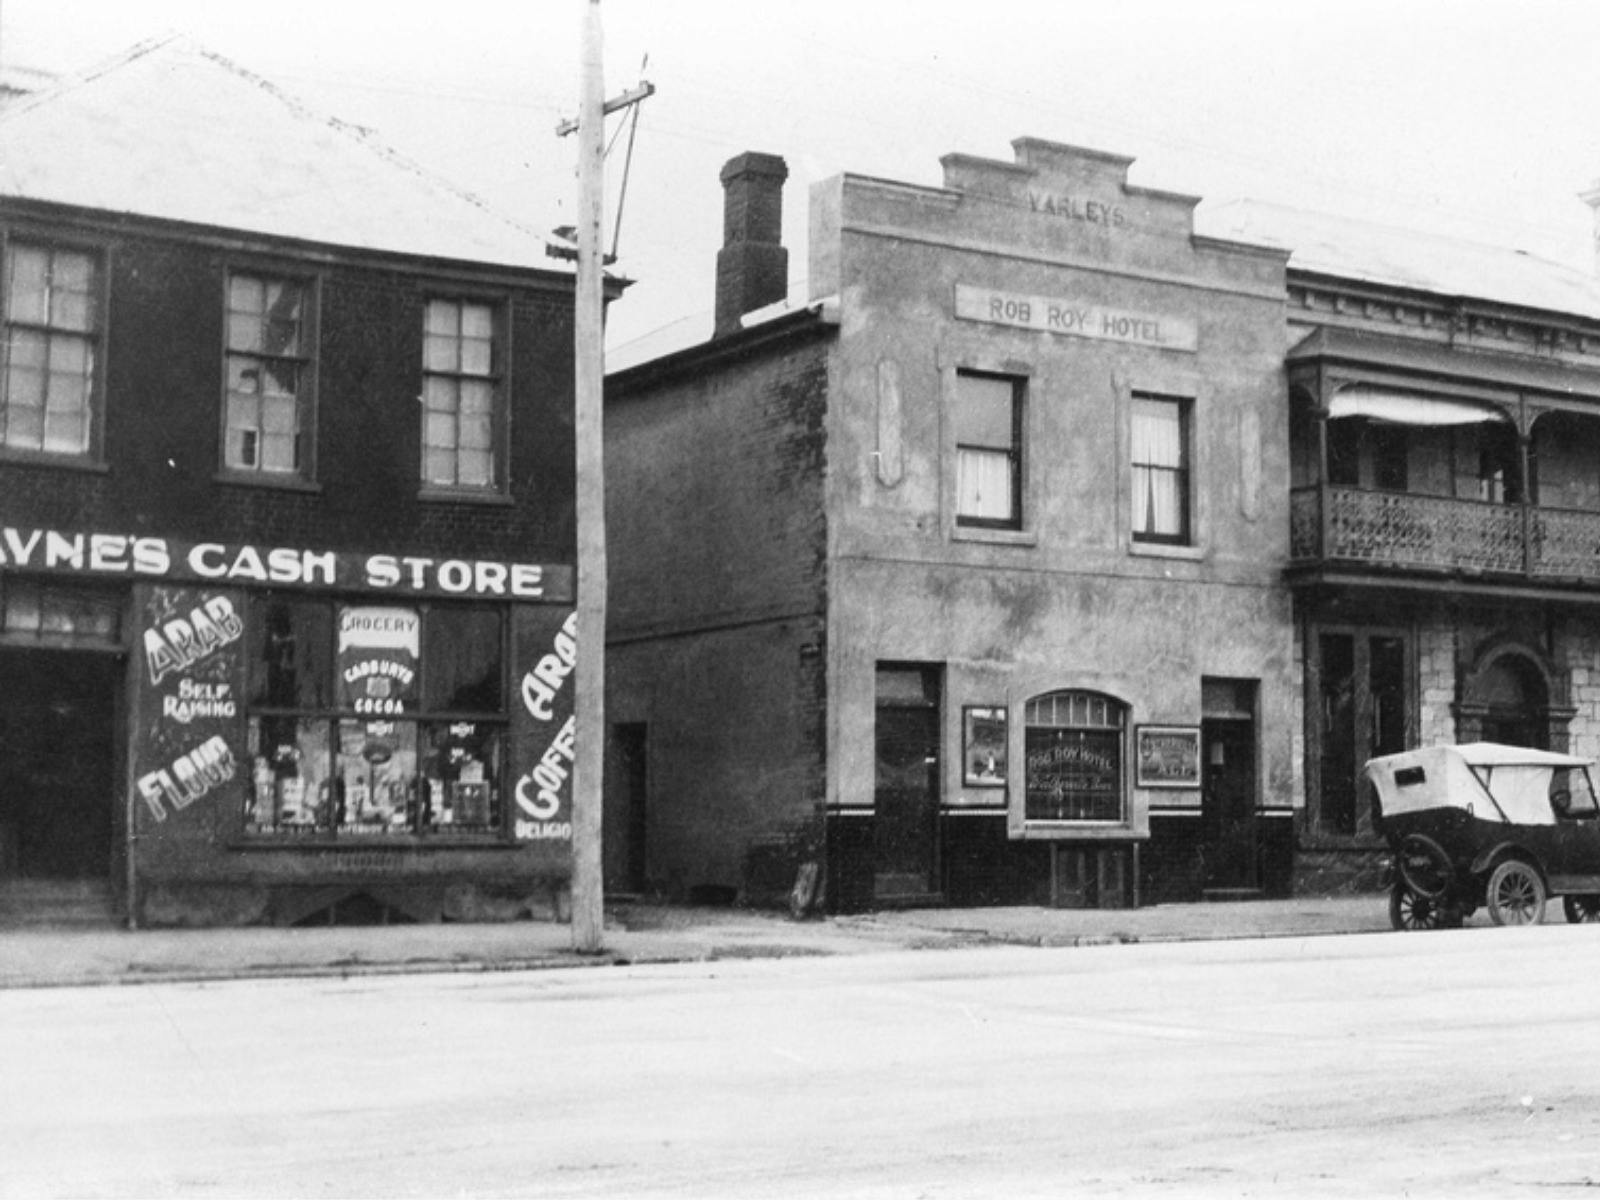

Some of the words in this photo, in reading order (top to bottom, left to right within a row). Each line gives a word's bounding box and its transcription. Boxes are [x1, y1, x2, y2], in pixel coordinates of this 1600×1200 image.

[989, 298, 1032, 323] ROB
[1047, 306, 1088, 331] ROY
[1102, 314, 1167, 343] HOTEL
[0, 527, 171, 575] YNE'S
[188, 542, 336, 584] CASH
[365, 554, 544, 596] STORE
[144, 595, 244, 686] ARAB
[342, 611, 416, 632] GROCERY
[163, 695, 237, 724] RAISING
[353, 698, 404, 715] COCOA
[137, 735, 238, 822] FLOUR
